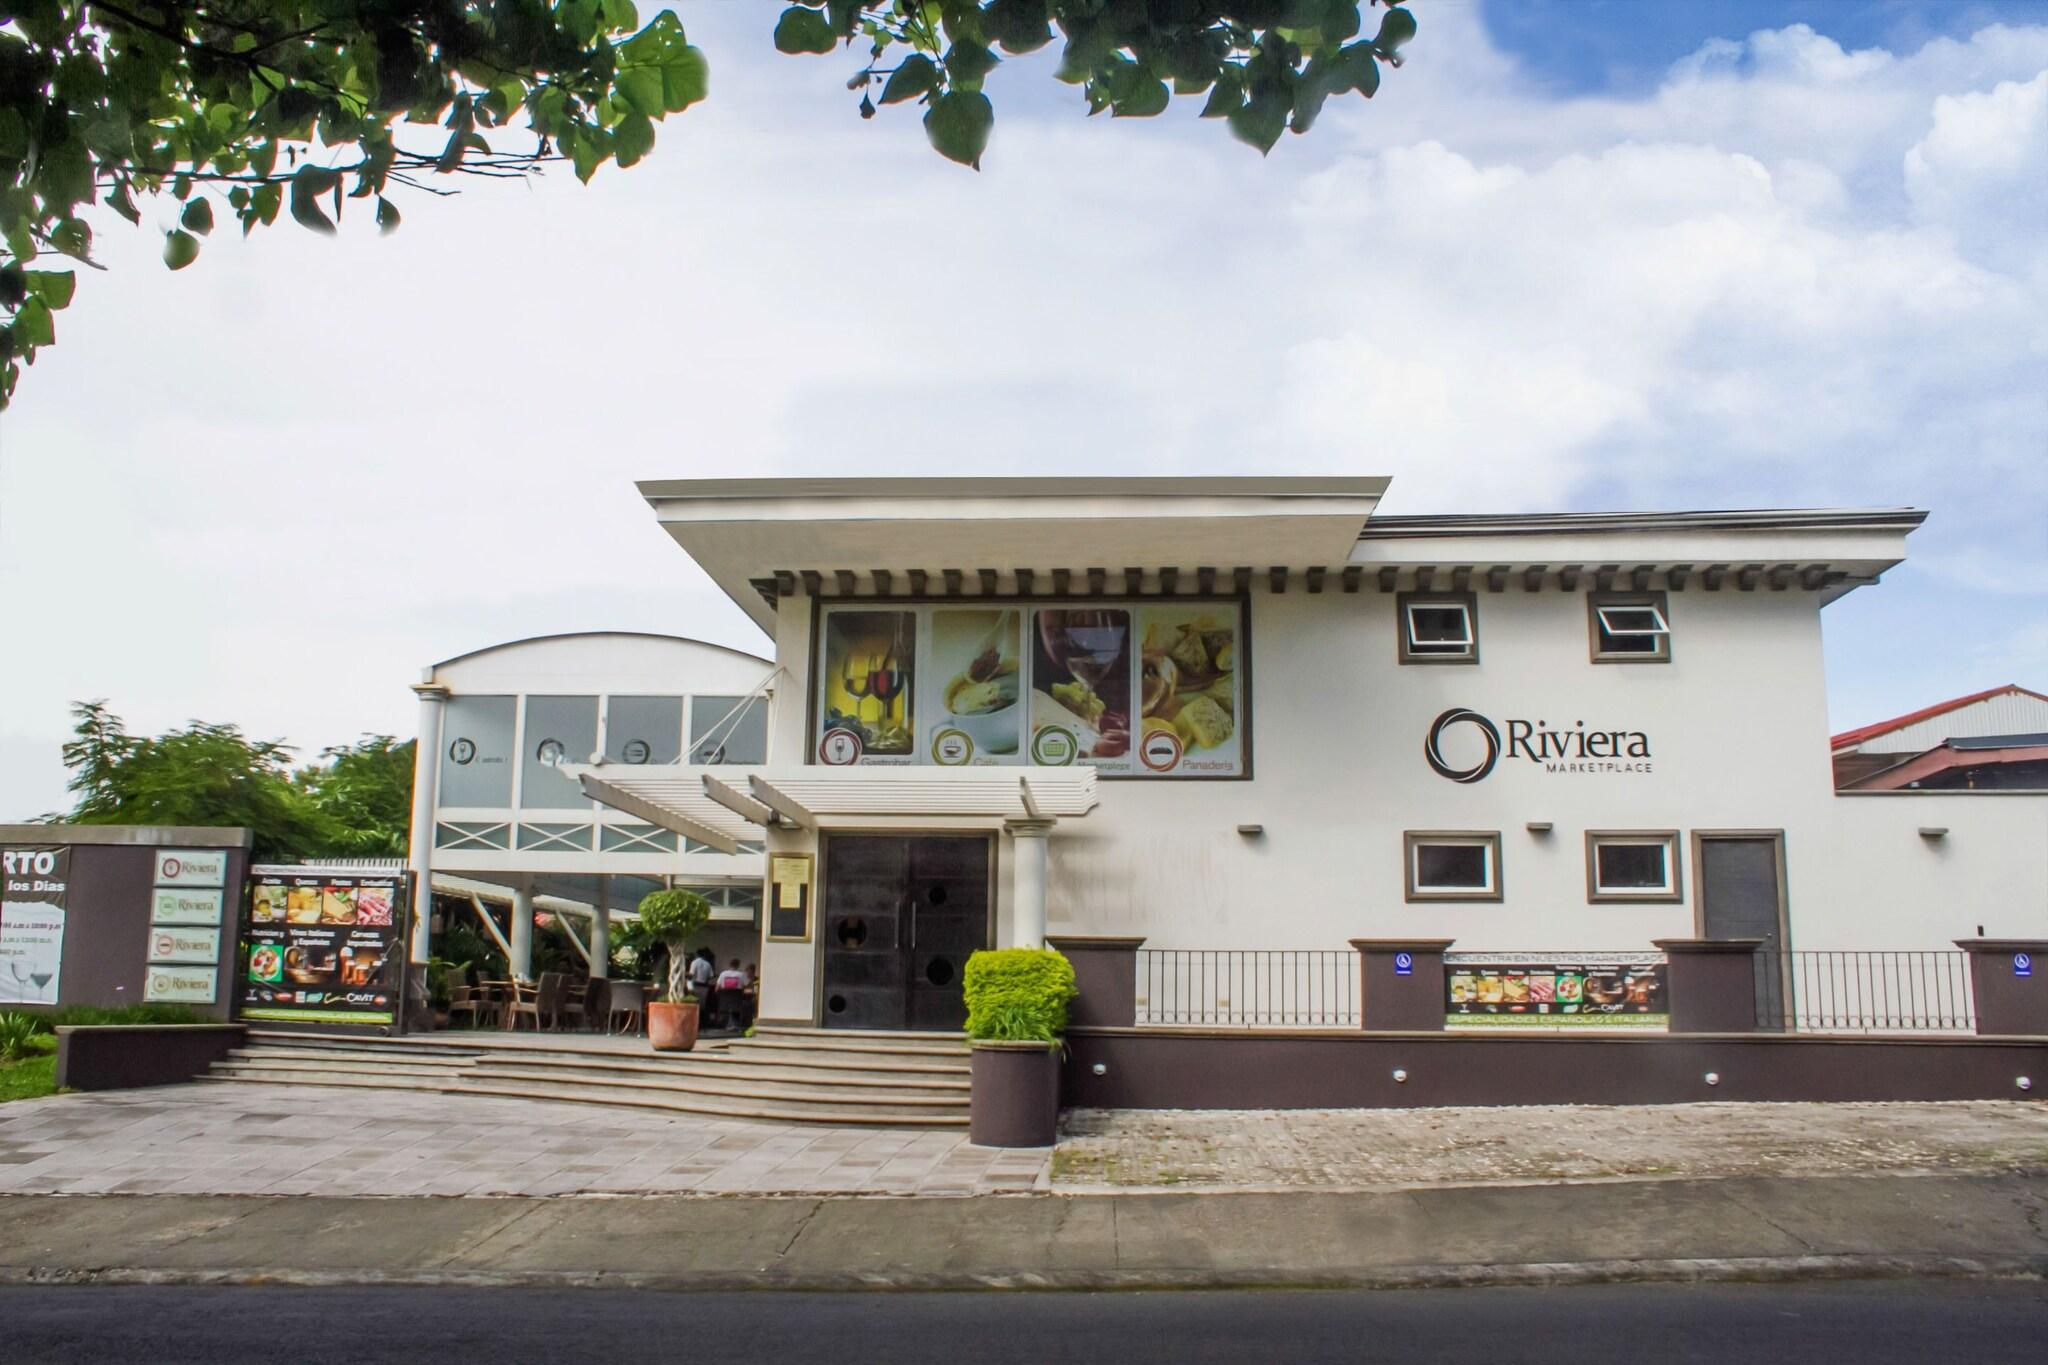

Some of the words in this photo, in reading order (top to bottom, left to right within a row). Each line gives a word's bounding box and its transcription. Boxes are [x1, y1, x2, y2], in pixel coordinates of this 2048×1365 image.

[1505, 719, 1652, 763] Riviera
[1546, 762, 1652, 773] MARKETPLACE
[182, 861, 217, 873] Riviera
[8, 879, 30, 892] los
[178, 899, 214, 911] Riviera
[175, 938, 211, 951] Riviera
[172, 977, 208, 989] Riviera
